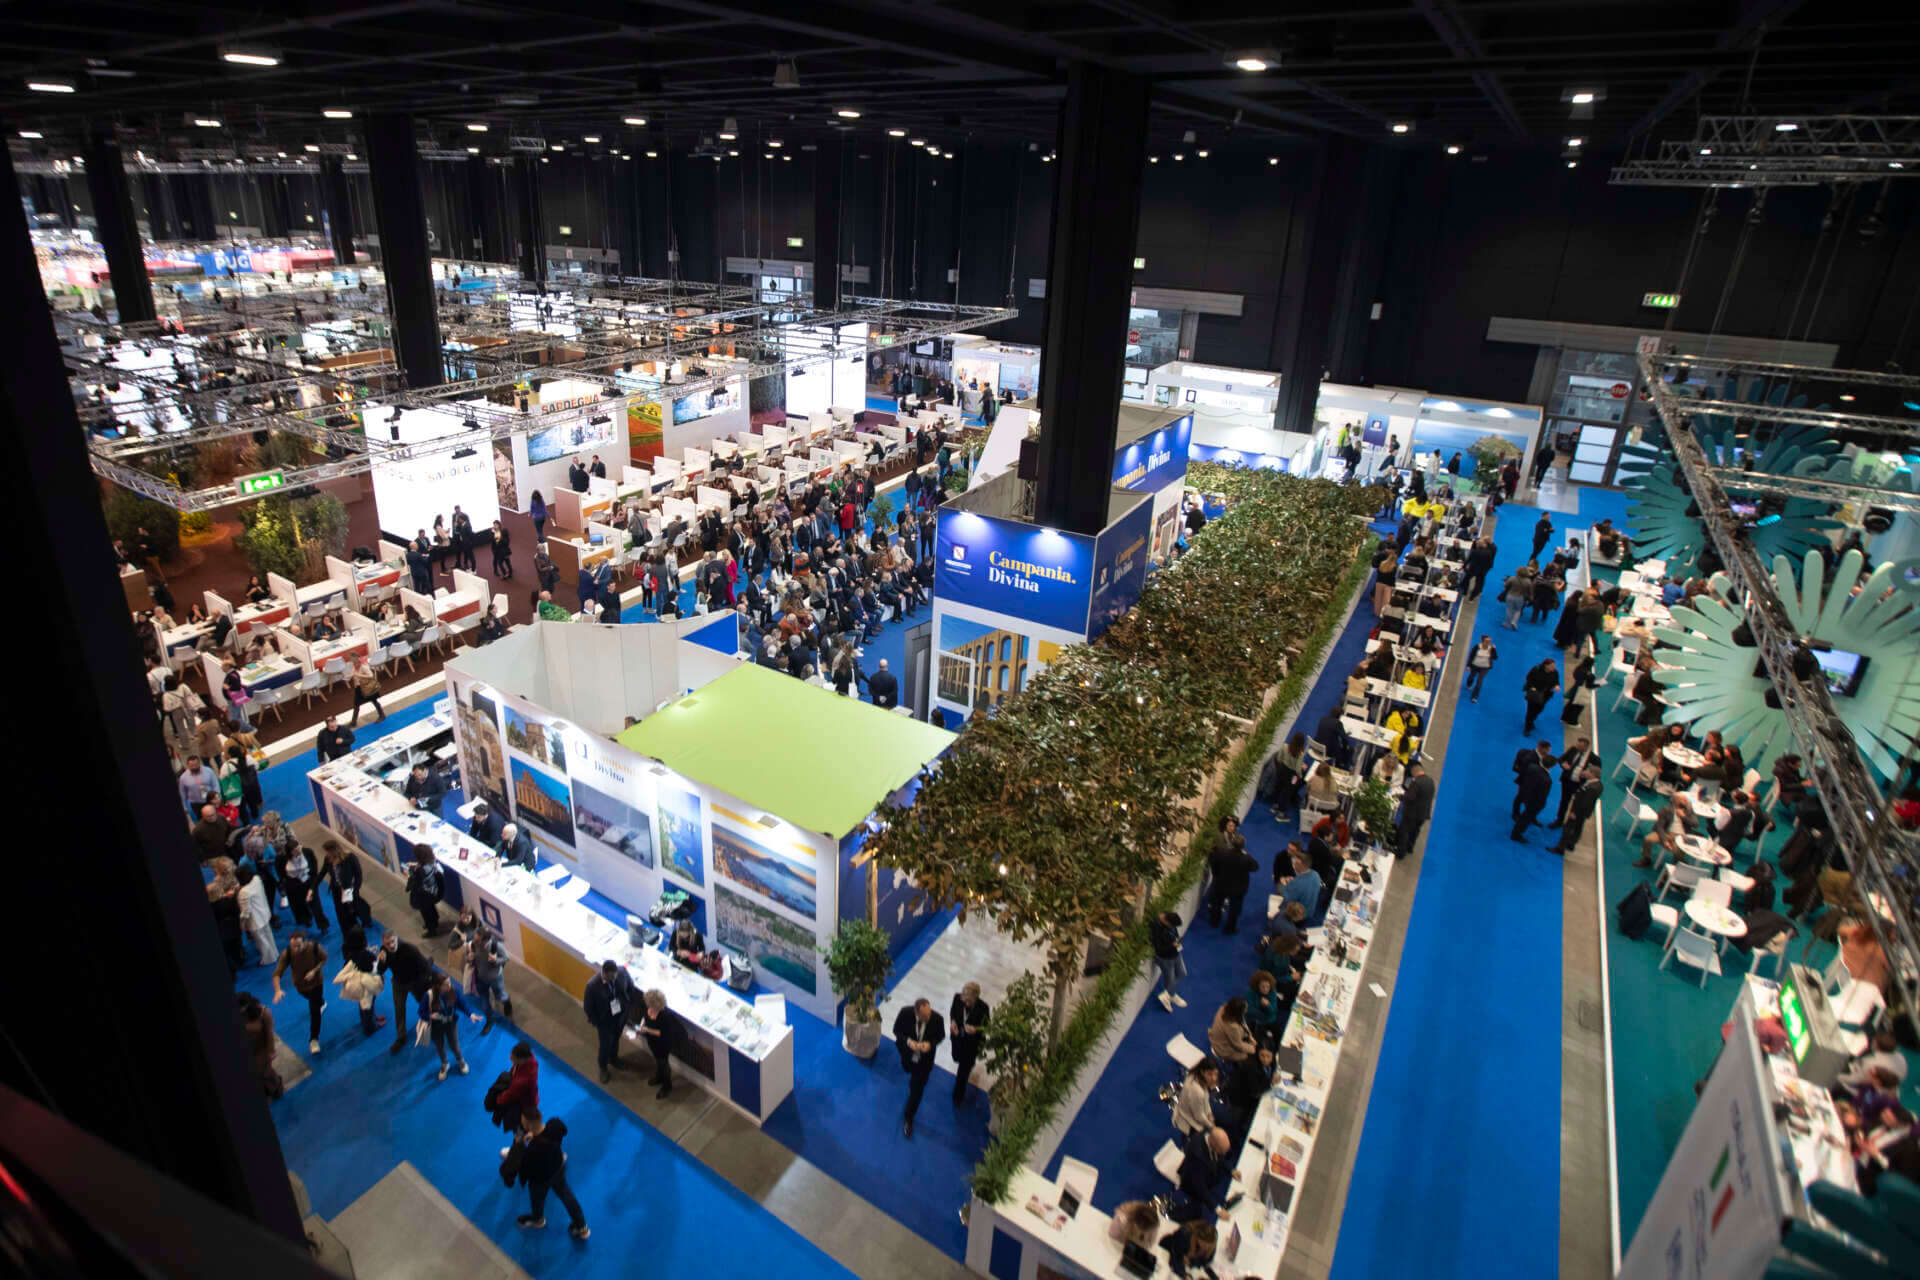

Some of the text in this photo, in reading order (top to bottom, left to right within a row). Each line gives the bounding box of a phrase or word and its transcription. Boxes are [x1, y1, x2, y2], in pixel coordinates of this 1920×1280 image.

[1611, 386, 1628, 395] STOP
[541, 394, 600, 415] SARDEGNA
[1147, 450, 1170, 473] Divina
[989, 551, 1076, 584] Campania.
[989, 567, 1039, 593] Divina
